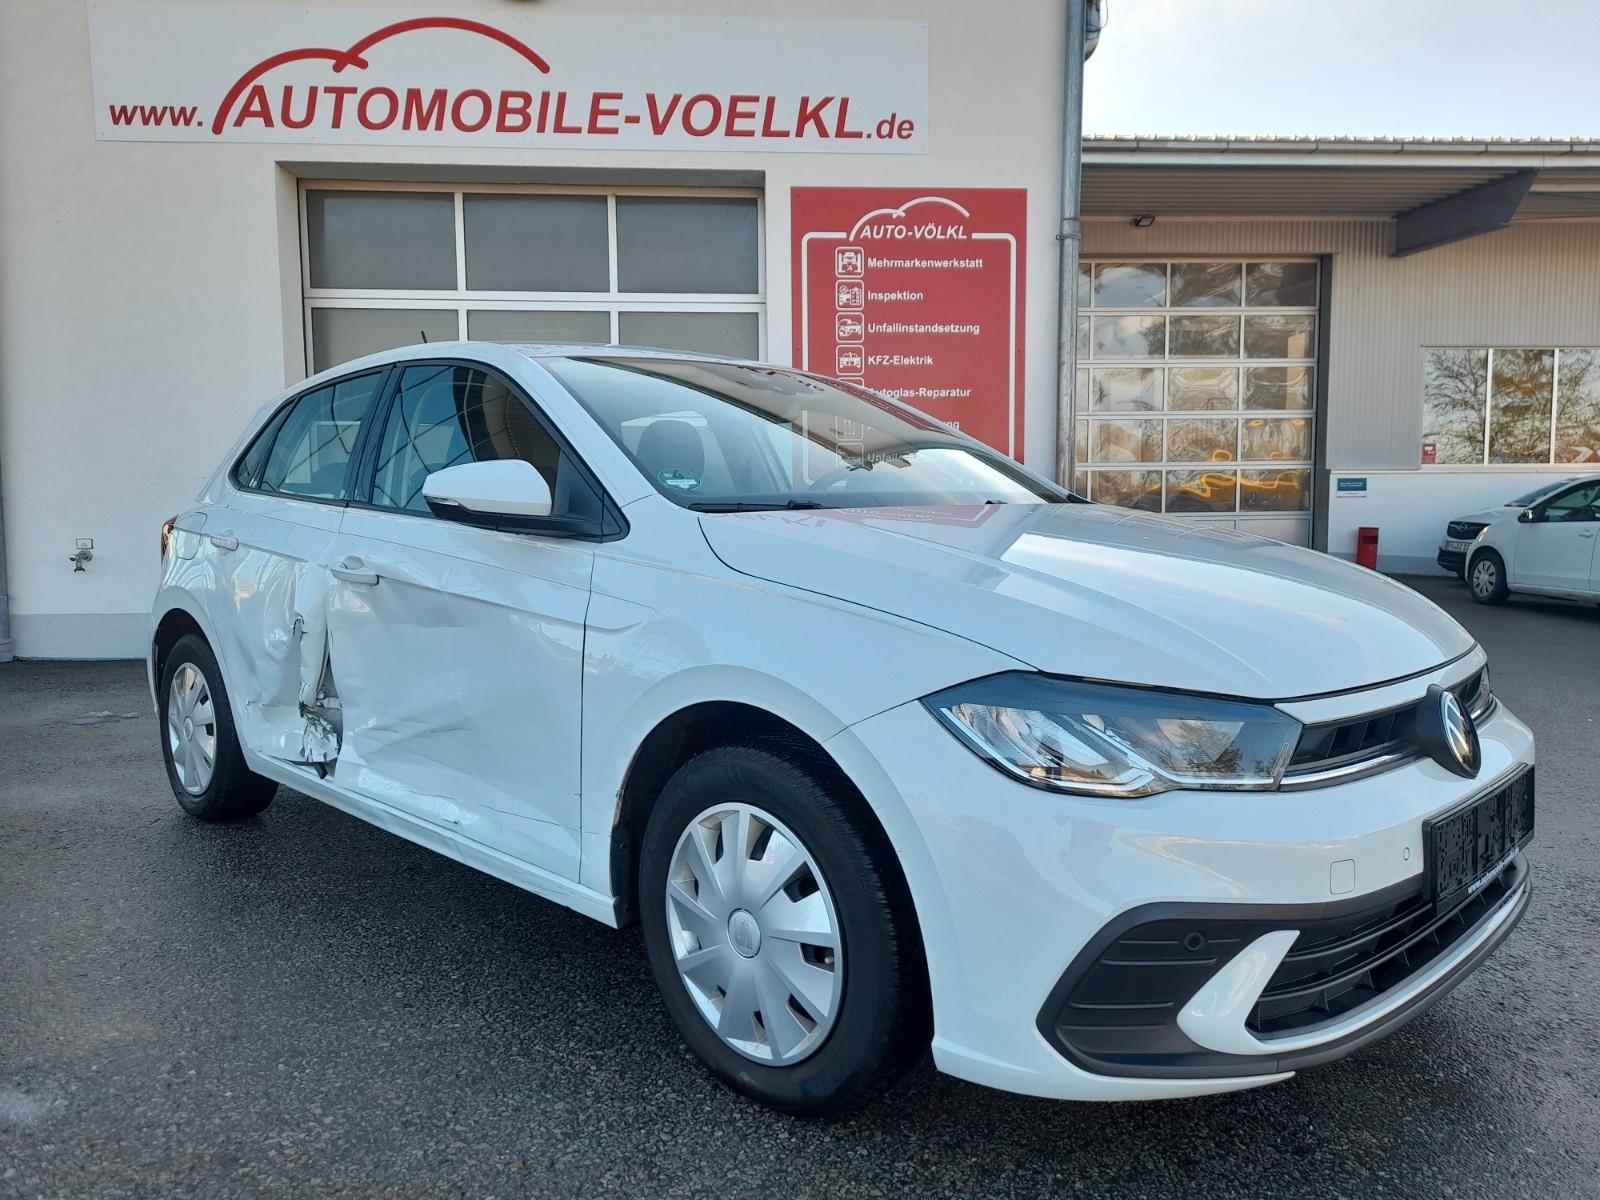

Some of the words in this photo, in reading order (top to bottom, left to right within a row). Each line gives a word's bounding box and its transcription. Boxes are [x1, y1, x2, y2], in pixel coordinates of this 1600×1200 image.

[860, 222, 967, 240] AUTO-VÖLKL
[867, 257, 983, 268] Mehrmarkenwerkstatt
[867, 290, 924, 302] Inspektion
[867, 322, 980, 335] Unfallinstandsetzung
[867, 355, 934, 366] KFZ-Elektrik
